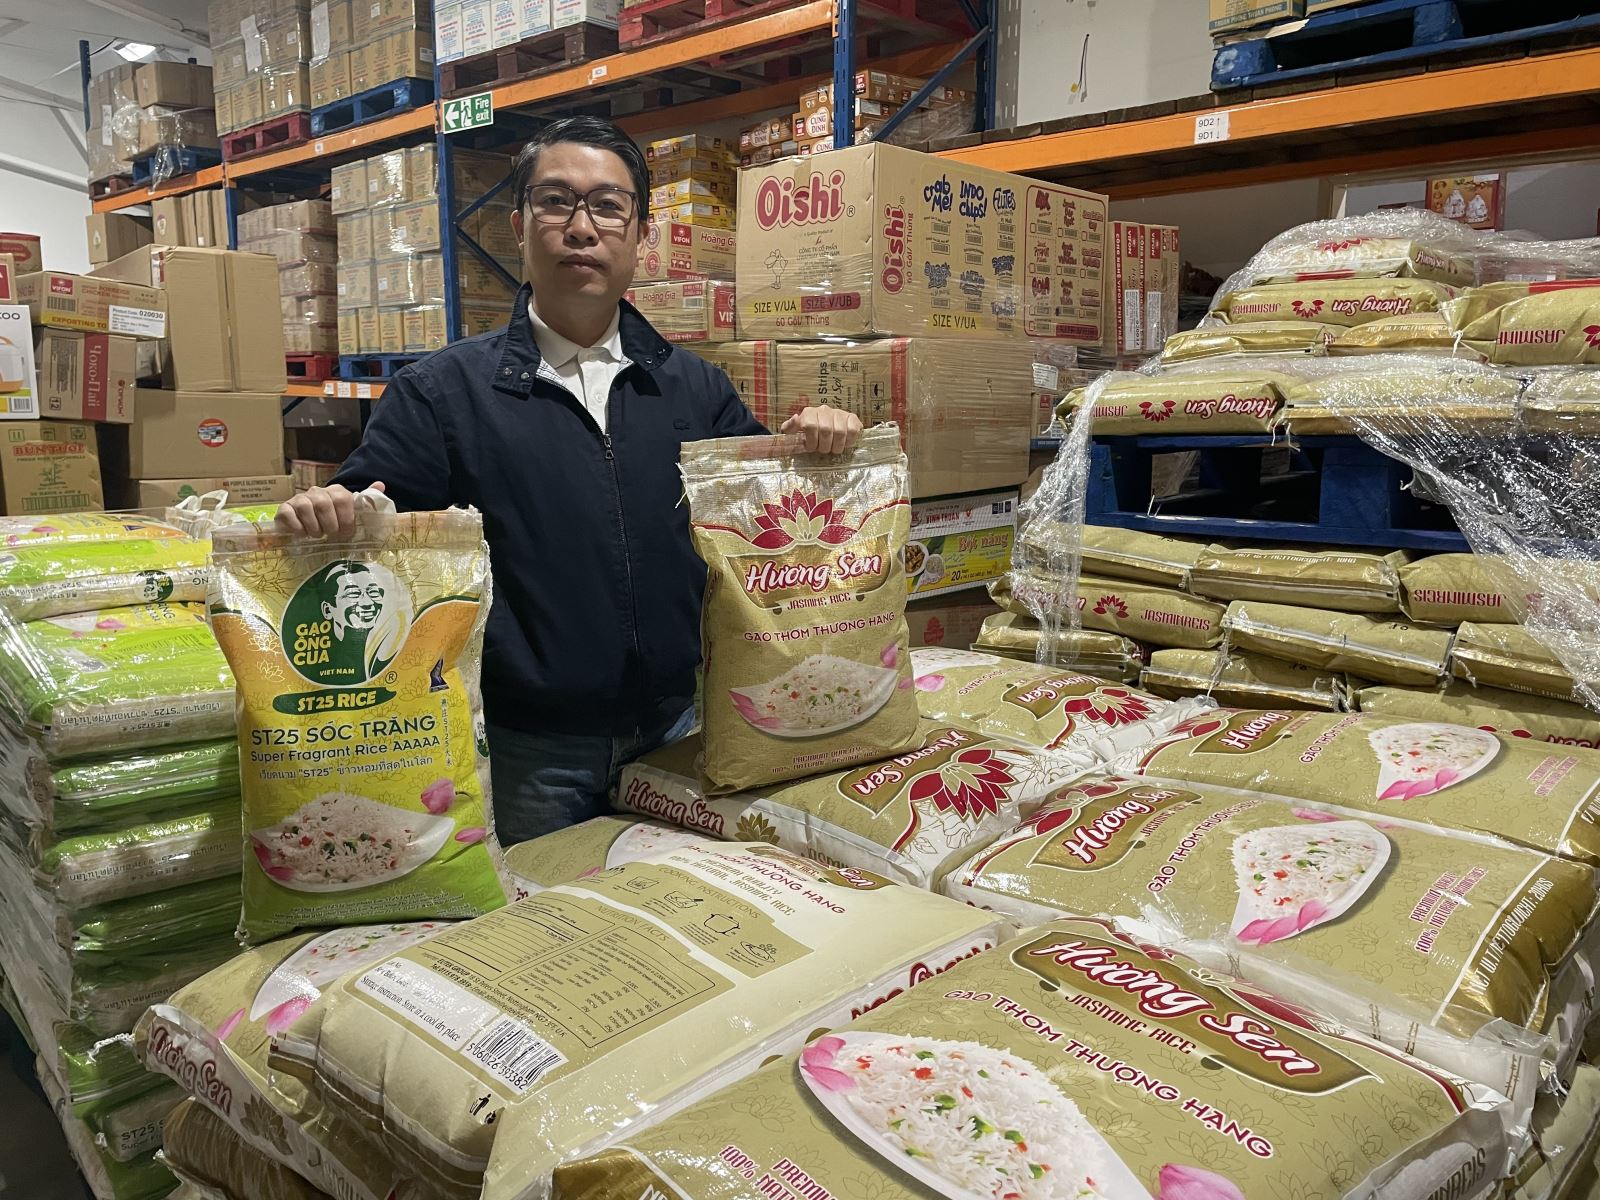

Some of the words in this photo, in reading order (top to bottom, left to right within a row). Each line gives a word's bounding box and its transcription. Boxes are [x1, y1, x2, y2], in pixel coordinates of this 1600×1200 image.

[475, 98, 489, 110] Fire
[475, 109, 490, 121] exit
[810, 116, 826, 127] CUNG
[1198, 118, 1214, 127] 9D2
[756, 169, 846, 231] Oishi
[924, 173, 951, 203] Crab
[959, 180, 985, 200] INDO
[673, 235, 691, 244] VIFON
[881, 203, 905, 295] Oishi
[139, 310, 164, 319] 020030
[754, 302, 771, 313] SIZE
[775, 301, 797, 312] V/UA
[806, 298, 825, 308] SIZE
[1331, 299, 1358, 316] Sen
[52, 316, 96, 328] EXPORTING
[776, 318, 786, 326] 60
[932, 313, 952, 328] SIZE
[954, 315, 977, 330] V/UA
[817, 361, 828, 394] Strips
[50, 399, 60, 409] 12
[1184, 399, 1217, 418] Sen
[745, 560, 831, 593] Hương
[836, 551, 882, 580] Sen
[951, 570, 961, 581] 20
[787, 596, 828, 610] JASMINE
[830, 592, 852, 604] RICE
[295, 620, 331, 637] GẠO
[1140, 608, 1210, 632] JASMINREIS
[294, 635, 331, 652] ÔNG
[293, 650, 330, 666] CUA
[297, 695, 335, 712] ST25
[337, 690, 377, 708] RICE
[1017, 683, 1059, 704] Sen
[252, 729, 300, 747] ST25
[305, 720, 353, 744] SÓC
[360, 715, 436, 739] TRĂNG
[1217, 710, 1294, 750] Hương
[251, 750, 285, 765] Super
[288, 746, 351, 764] Fragrant
[355, 742, 388, 757] Rice
[393, 734, 441, 752] AAAAA
[850, 764, 905, 796] Sen
[624, 777, 686, 825] Hương
[686, 798, 725, 836] Sen
[1061, 798, 1155, 864] Hương
[1129, 788, 1181, 805] Sen
[1147, 864, 1177, 893] GẠO
[658, 866, 698, 888] COOKING
[698, 885, 762, 919] INSTRUCTIONS
[801, 889, 847, 915] HẠNG
[1410, 887, 1443, 923] PREMIUM
[770, 898, 797, 917] RICE
[596, 905, 649, 930] NUTRITION
[647, 924, 671, 943] FACTS
[1414, 928, 1440, 954] 100%
[401, 999, 415, 1012] Store
[423, 1012, 437, 1028] cool
[434, 1019, 446, 1034] dry
[442, 1025, 461, 1042] place
[505, 994, 537, 1017] Nottingham
[534, 1011, 549, 1025] NG7
[1027, 939, 1216, 1019] Hương
[1199, 1011, 1323, 1077] Sen
[1064, 993, 1147, 1035] JASMINE
[1146, 1026, 1198, 1055] RICE
[466, 1042, 476, 1052] 5
[472, 1046, 499, 1071] 060126
[497, 1065, 529, 1091] 393382
[993, 995, 1064, 1044] THƠM
[1063, 1037, 1180, 1102] THƯỢNG
[1182, 1097, 1275, 1160] HẠNG
[197, 1058, 234, 1116] Sen
[120, 1123, 155, 1141] ST25
[718, 1144, 759, 1181] 100%
